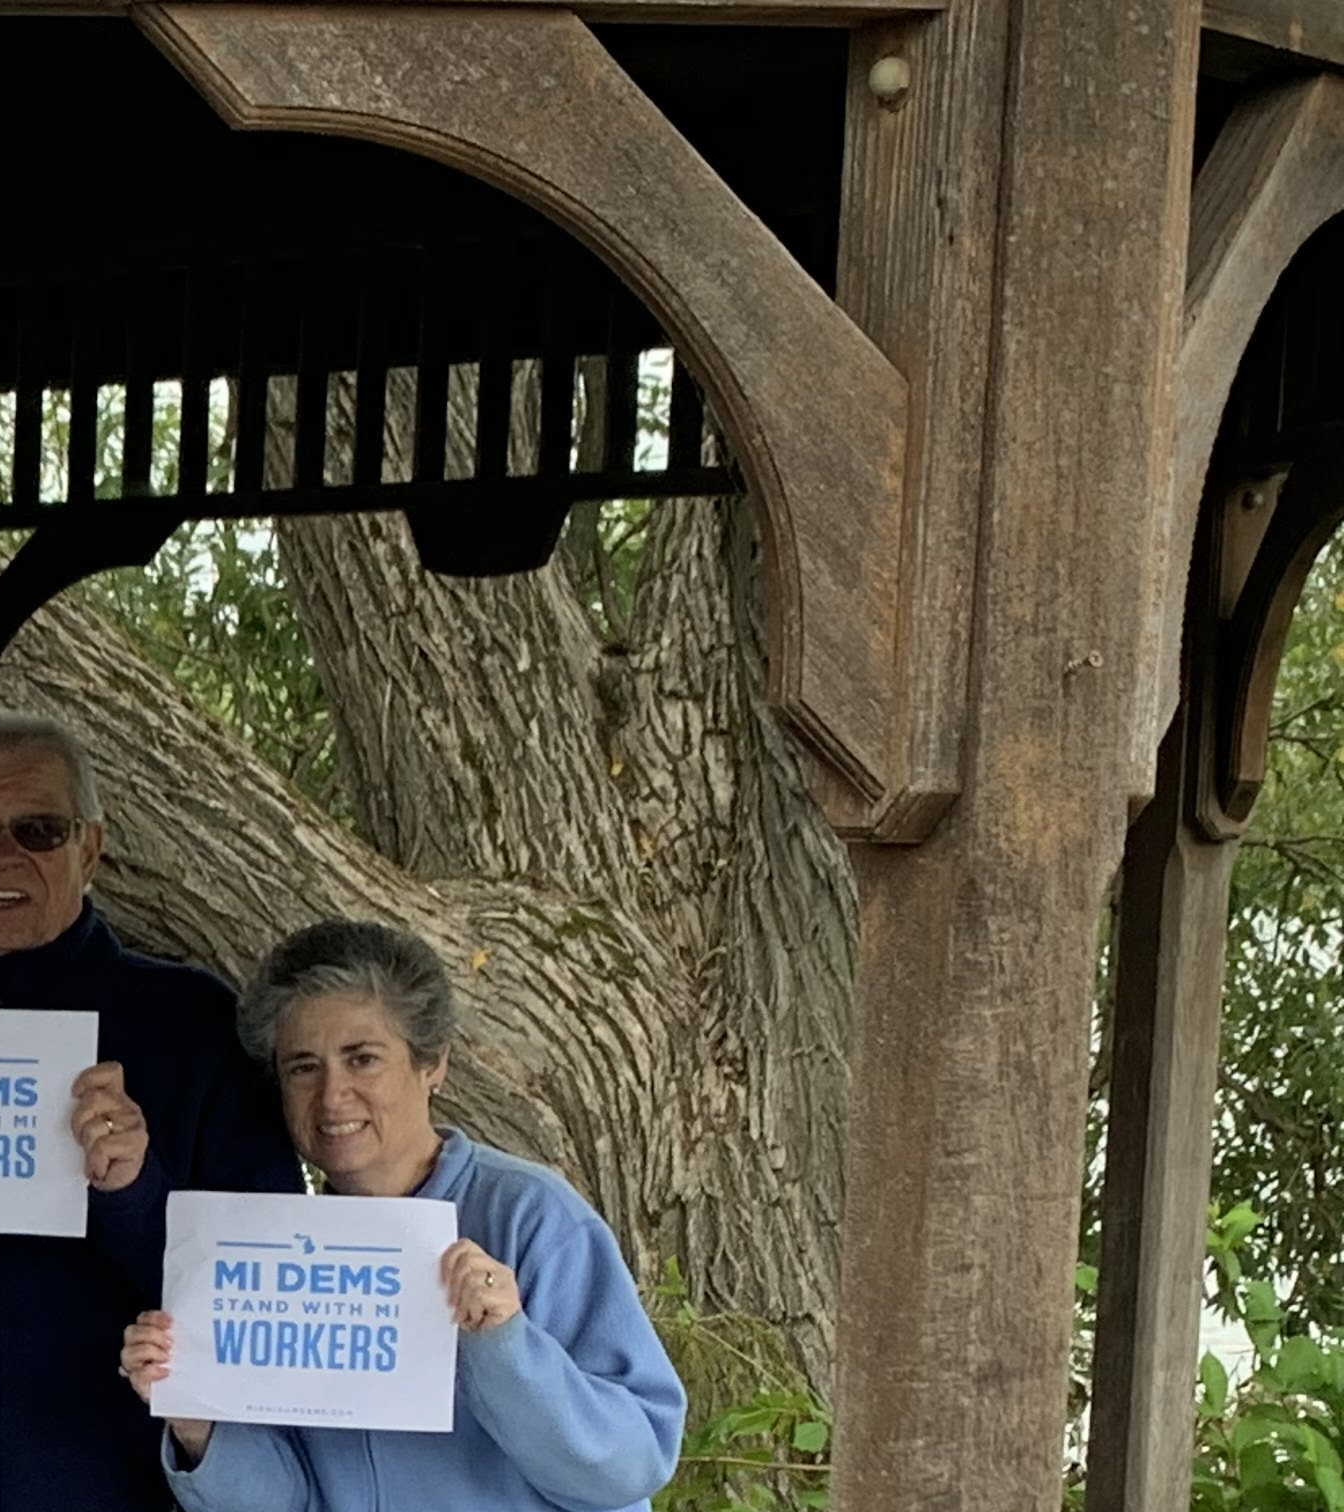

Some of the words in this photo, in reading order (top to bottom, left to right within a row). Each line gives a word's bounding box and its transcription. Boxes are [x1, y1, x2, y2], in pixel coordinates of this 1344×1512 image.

[14, 1115, 37, 1128] MI
[215, 1261, 259, 1290] MI
[278, 1264, 401, 1297] DEMS
[213, 1298, 289, 1313] STAND
[302, 1303, 362, 1316] WITH
[375, 1304, 399, 1318] MI
[214, 1319, 397, 1372] WORKERS
